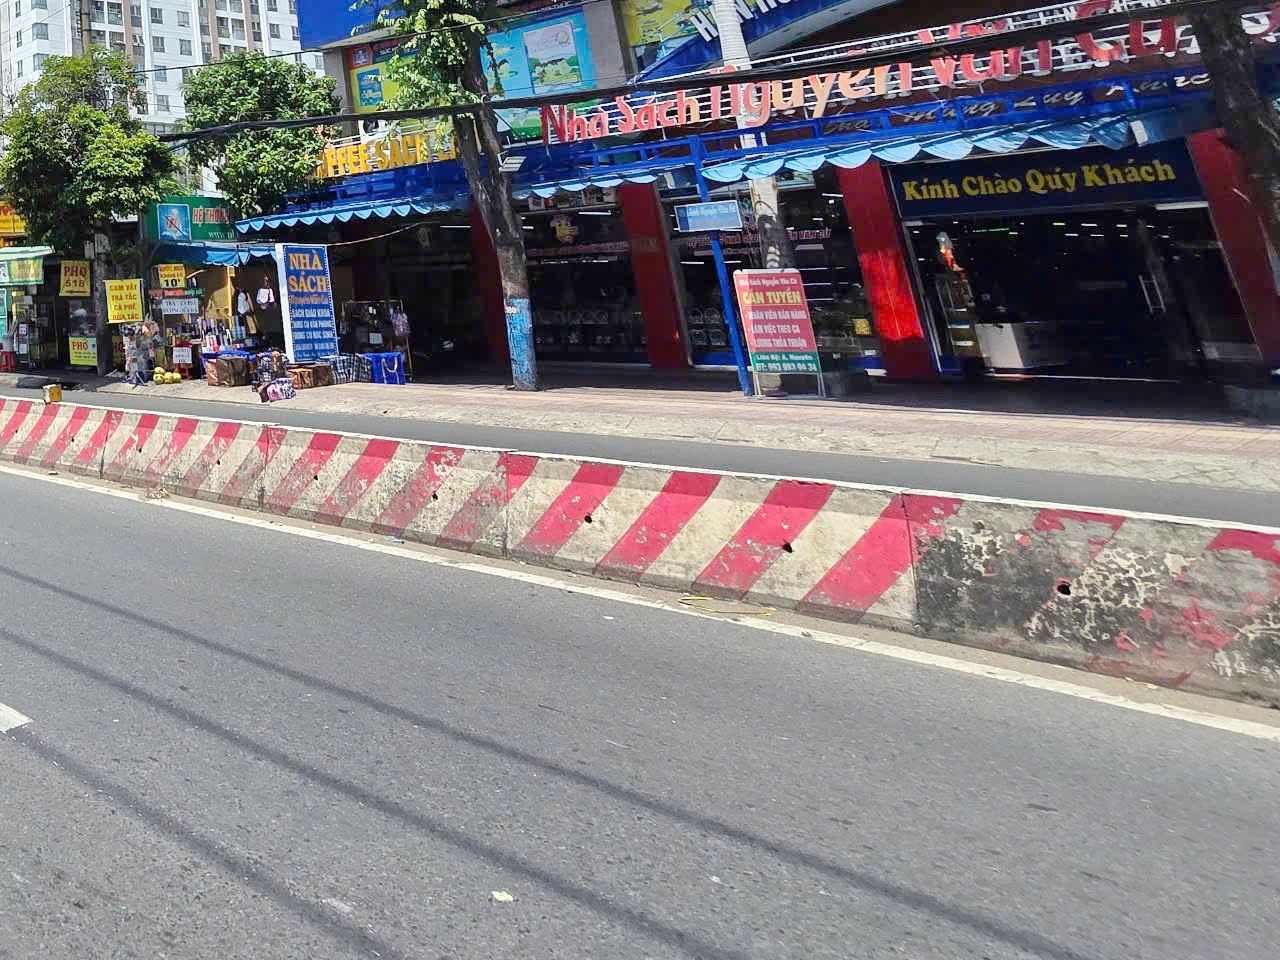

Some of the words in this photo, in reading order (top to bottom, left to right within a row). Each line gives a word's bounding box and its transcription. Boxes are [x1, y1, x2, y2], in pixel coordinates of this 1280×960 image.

[540, 102, 609, 146] Nhà
[616, 89, 701, 135] Sách
[902, 177, 960, 201] Kính
[962, 173, 1023, 197] Chào
[1025, 167, 1078, 195] Quý
[1080, 158, 1177, 188] Khách
[288, 249, 324, 270] NHÀ
[65, 279, 86, 288] 518
[288, 271, 328, 292] SÁCH
